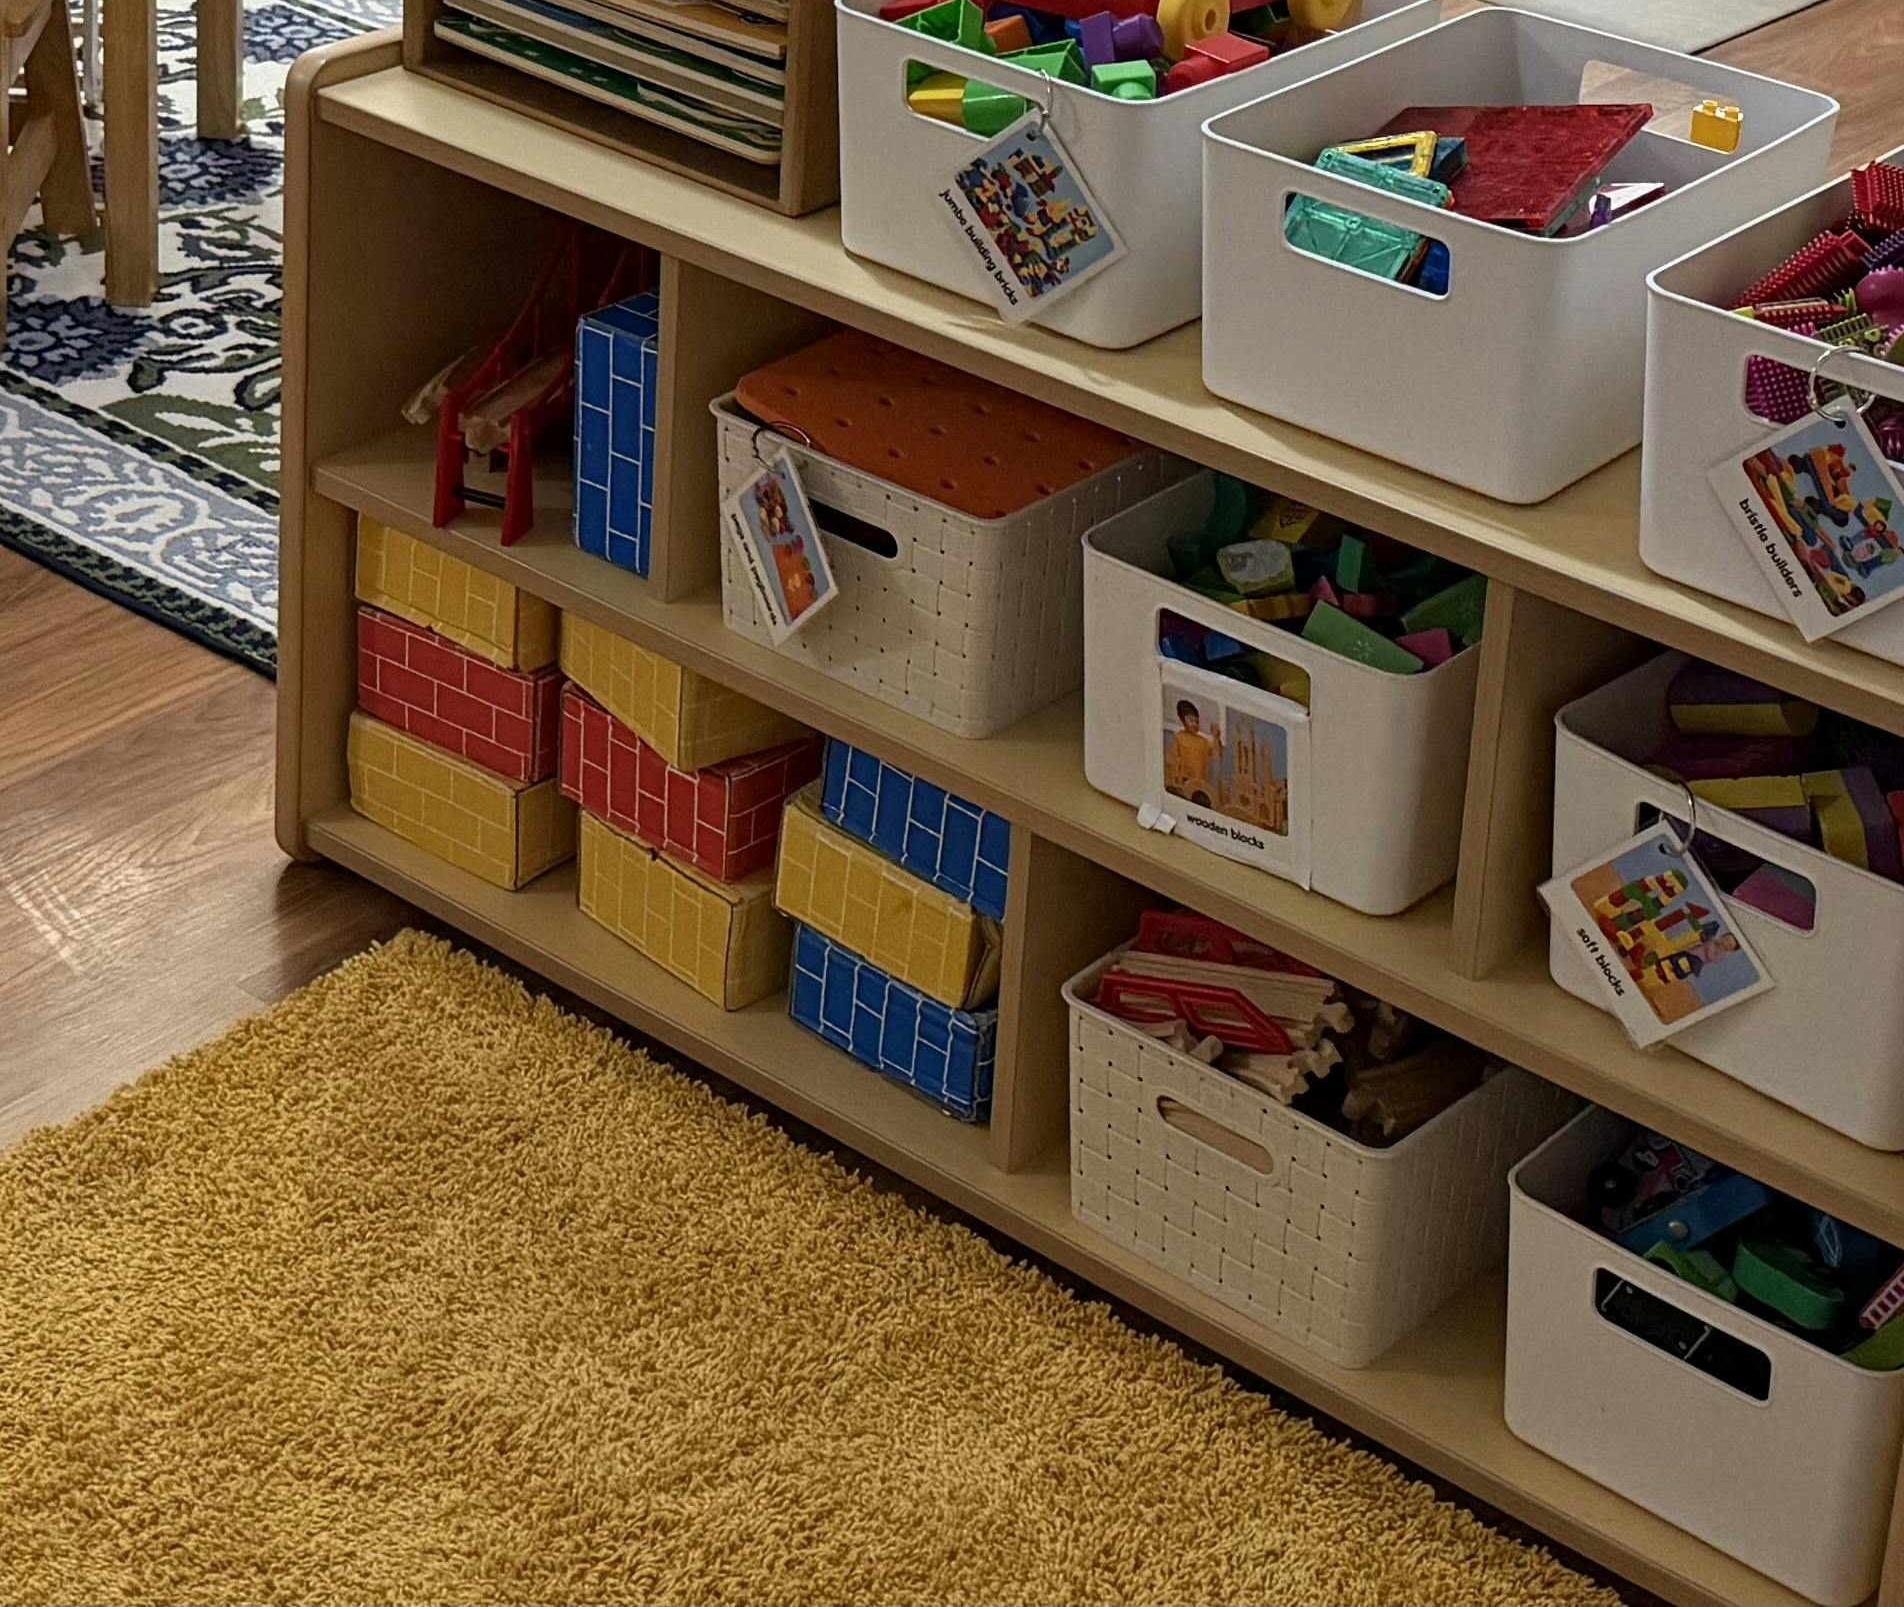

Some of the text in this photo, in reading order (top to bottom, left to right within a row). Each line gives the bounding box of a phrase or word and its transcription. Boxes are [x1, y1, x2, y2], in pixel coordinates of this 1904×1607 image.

[938, 189, 1018, 305] jumbo building bricks
[1739, 498, 1803, 598] bristle builders
[1186, 814, 1265, 850] wooden blocks
[1576, 928, 1626, 996] soft blocks
